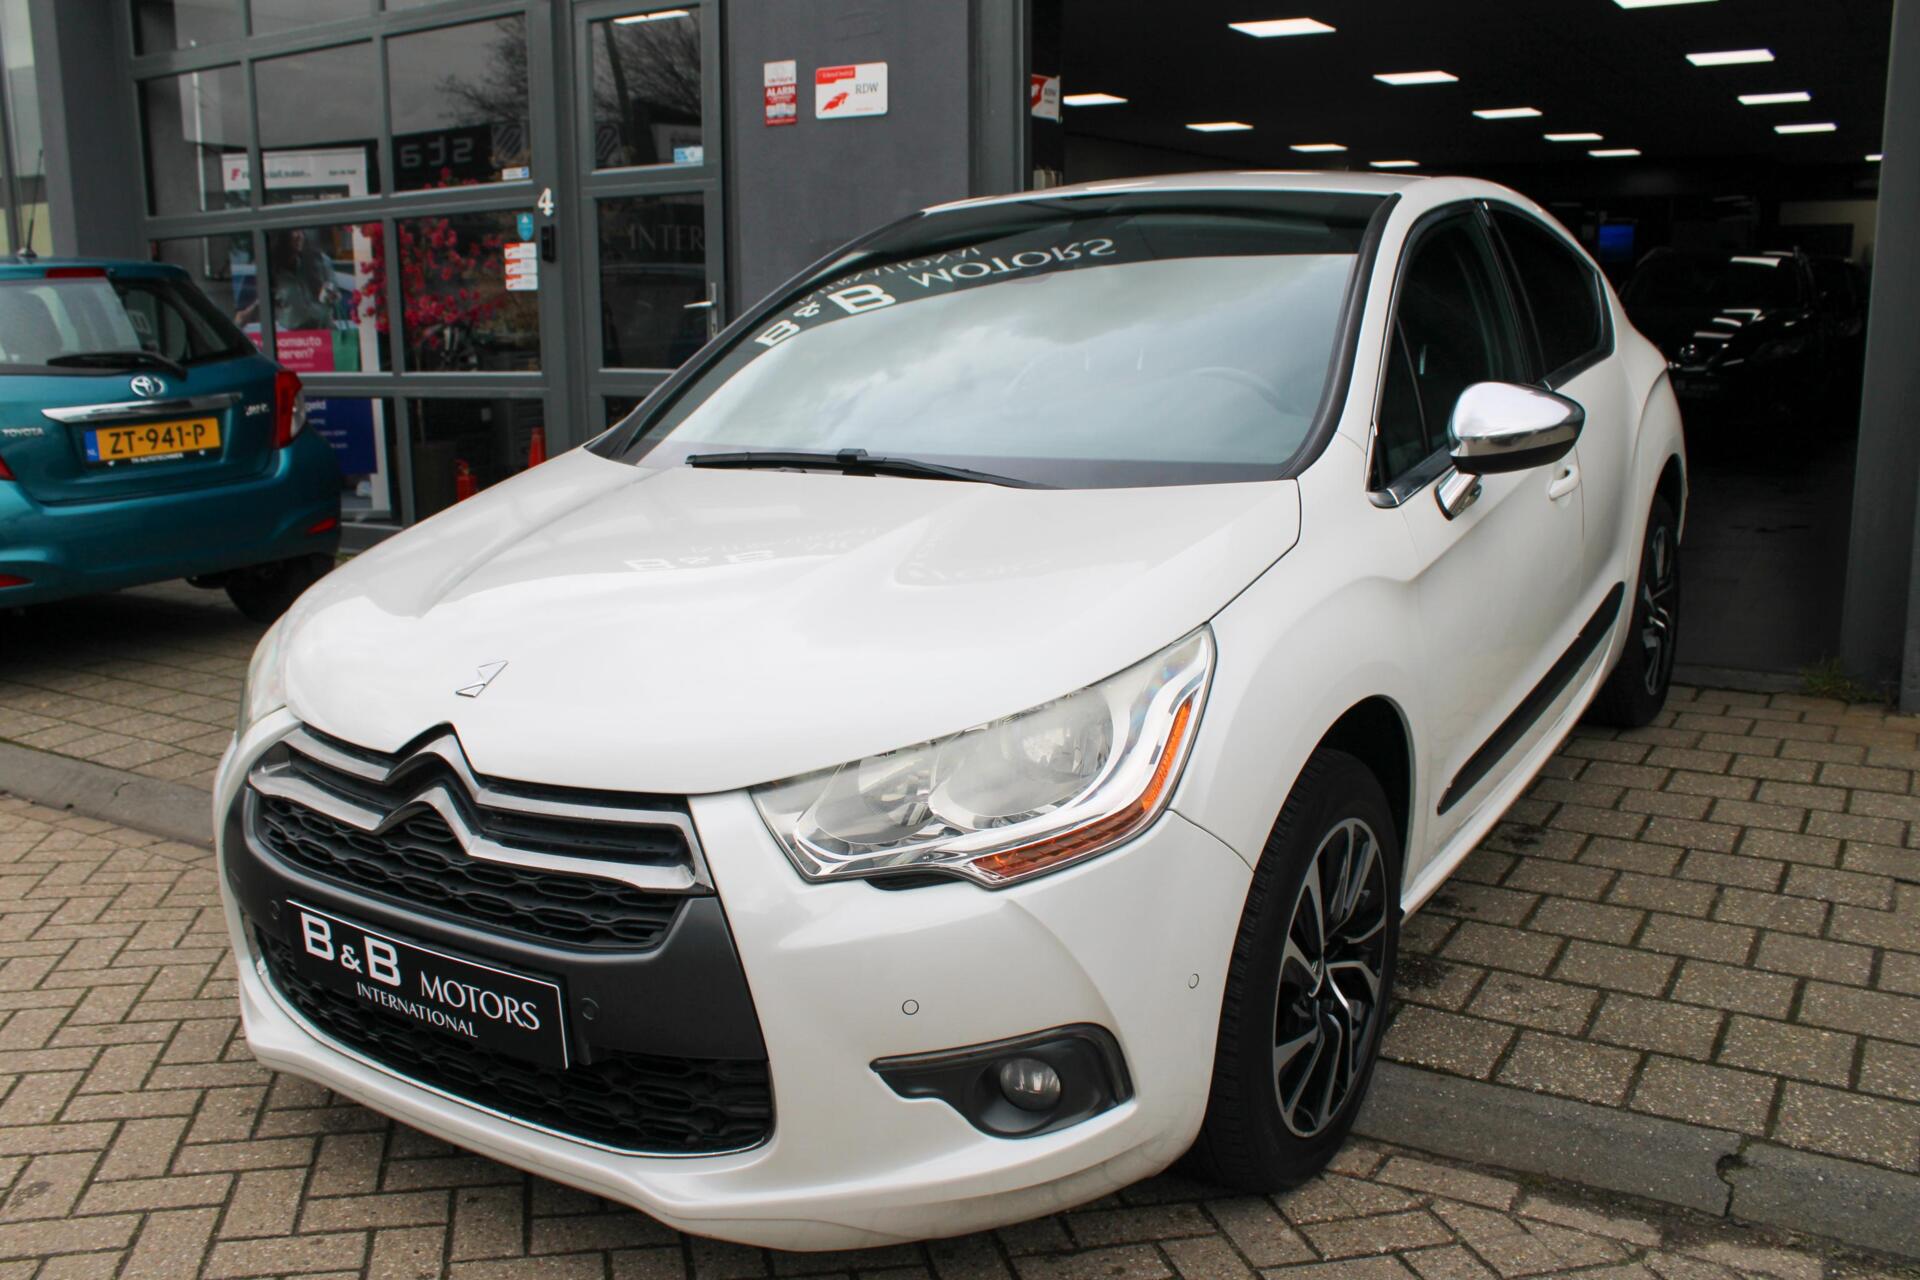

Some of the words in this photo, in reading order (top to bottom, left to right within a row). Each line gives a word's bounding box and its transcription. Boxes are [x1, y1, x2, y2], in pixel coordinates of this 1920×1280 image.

[766, 85, 796, 98] ALARM
[855, 82, 879, 95] RDW
[537, 187, 554, 216] 4
[2, 427, 44, 438] TOYOTA
[108, 424, 206, 455] ZT-941-P
[356, 980, 480, 1038] INTERNATIONAL
[419, 970, 541, 1030] MOTORS
